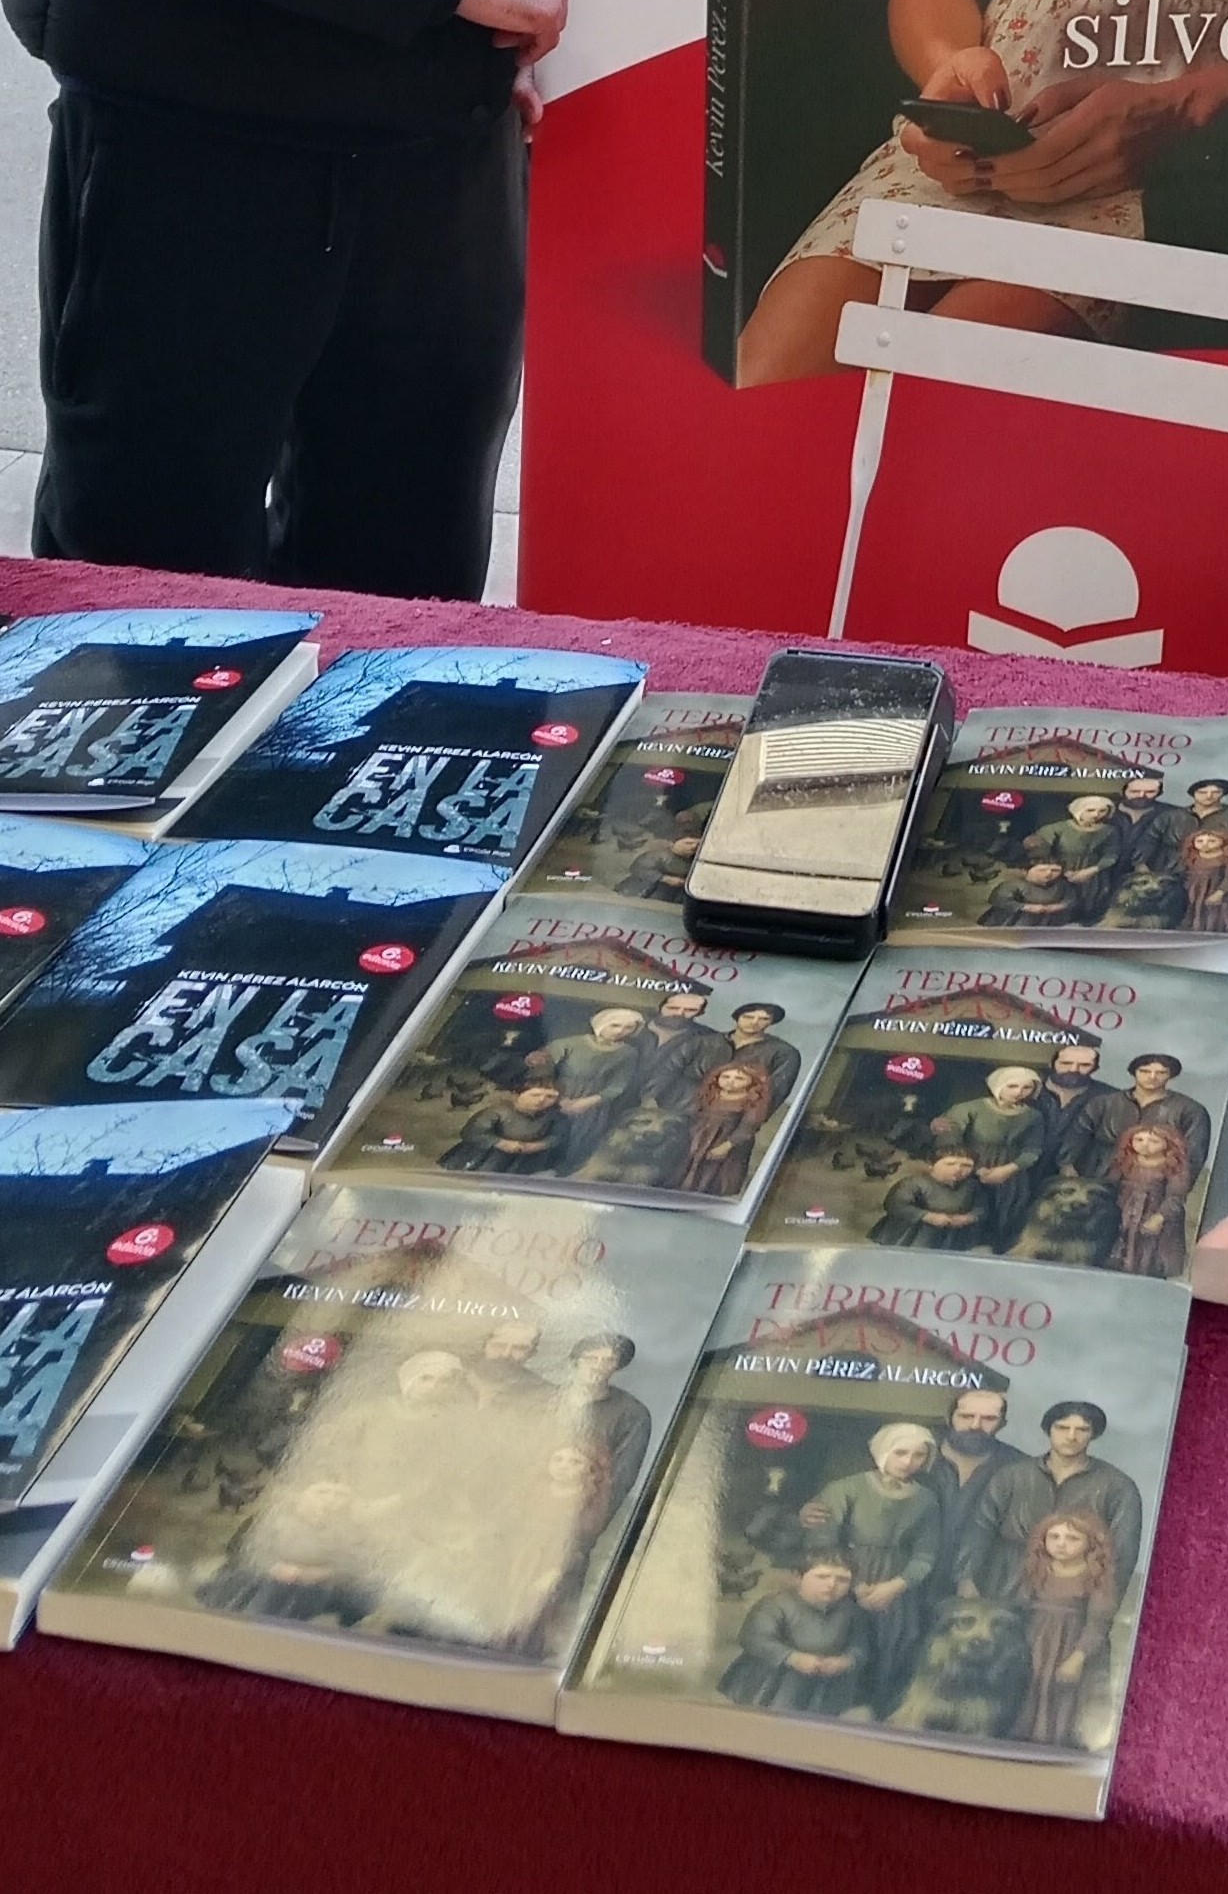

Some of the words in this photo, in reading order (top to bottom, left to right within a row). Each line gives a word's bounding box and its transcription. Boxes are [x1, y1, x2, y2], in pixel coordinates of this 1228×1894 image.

[705, 98, 726, 179] Kevin
[378, 744, 423, 754] KEVIN
[424, 746, 471, 756] PÉREZ
[472, 749, 543, 762] ALARCÓN
[637, 741, 684, 754] KEVIN
[985, 726, 1192, 749] TERRITORIO
[347, 752, 450, 791] EN
[460, 759, 540, 798] LA
[968, 764, 1015, 775] KEVIN
[1018, 765, 1070, 777] PÉREZ
[1071, 767, 1146, 780] ALARCÓN
[312, 787, 531, 848] CASA
[177, 969, 227, 982] KEVIN
[230, 972, 285, 986] PÉREZ
[286, 976, 369, 993] ALARCÓN
[492, 961, 547, 974] KEVIN
[548, 964, 607, 982] PÉREZ
[608, 973, 693, 995] ALARCÓN
[898, 969, 1138, 1007] TERRITORIO
[130, 979, 261, 1028] EN
[260, 989, 364, 1038] LA
[873, 1018, 928, 1033] KEVIN
[932, 1019, 992, 1038] PÉREZ
[992, 1025, 1080, 1046] ALARCÓN
[86, 1023, 349, 1109] CASA
[15, 1280, 114, 1300] ALARCÓN
[283, 1282, 347, 1301] KEVIN
[765, 1282, 1052, 1332] TERRITORIO
[734, 1353, 800, 1373] KEVIN
[805, 1355, 876, 1380] PÉREZ
[878, 1364, 983, 1390] ALARCÓN
